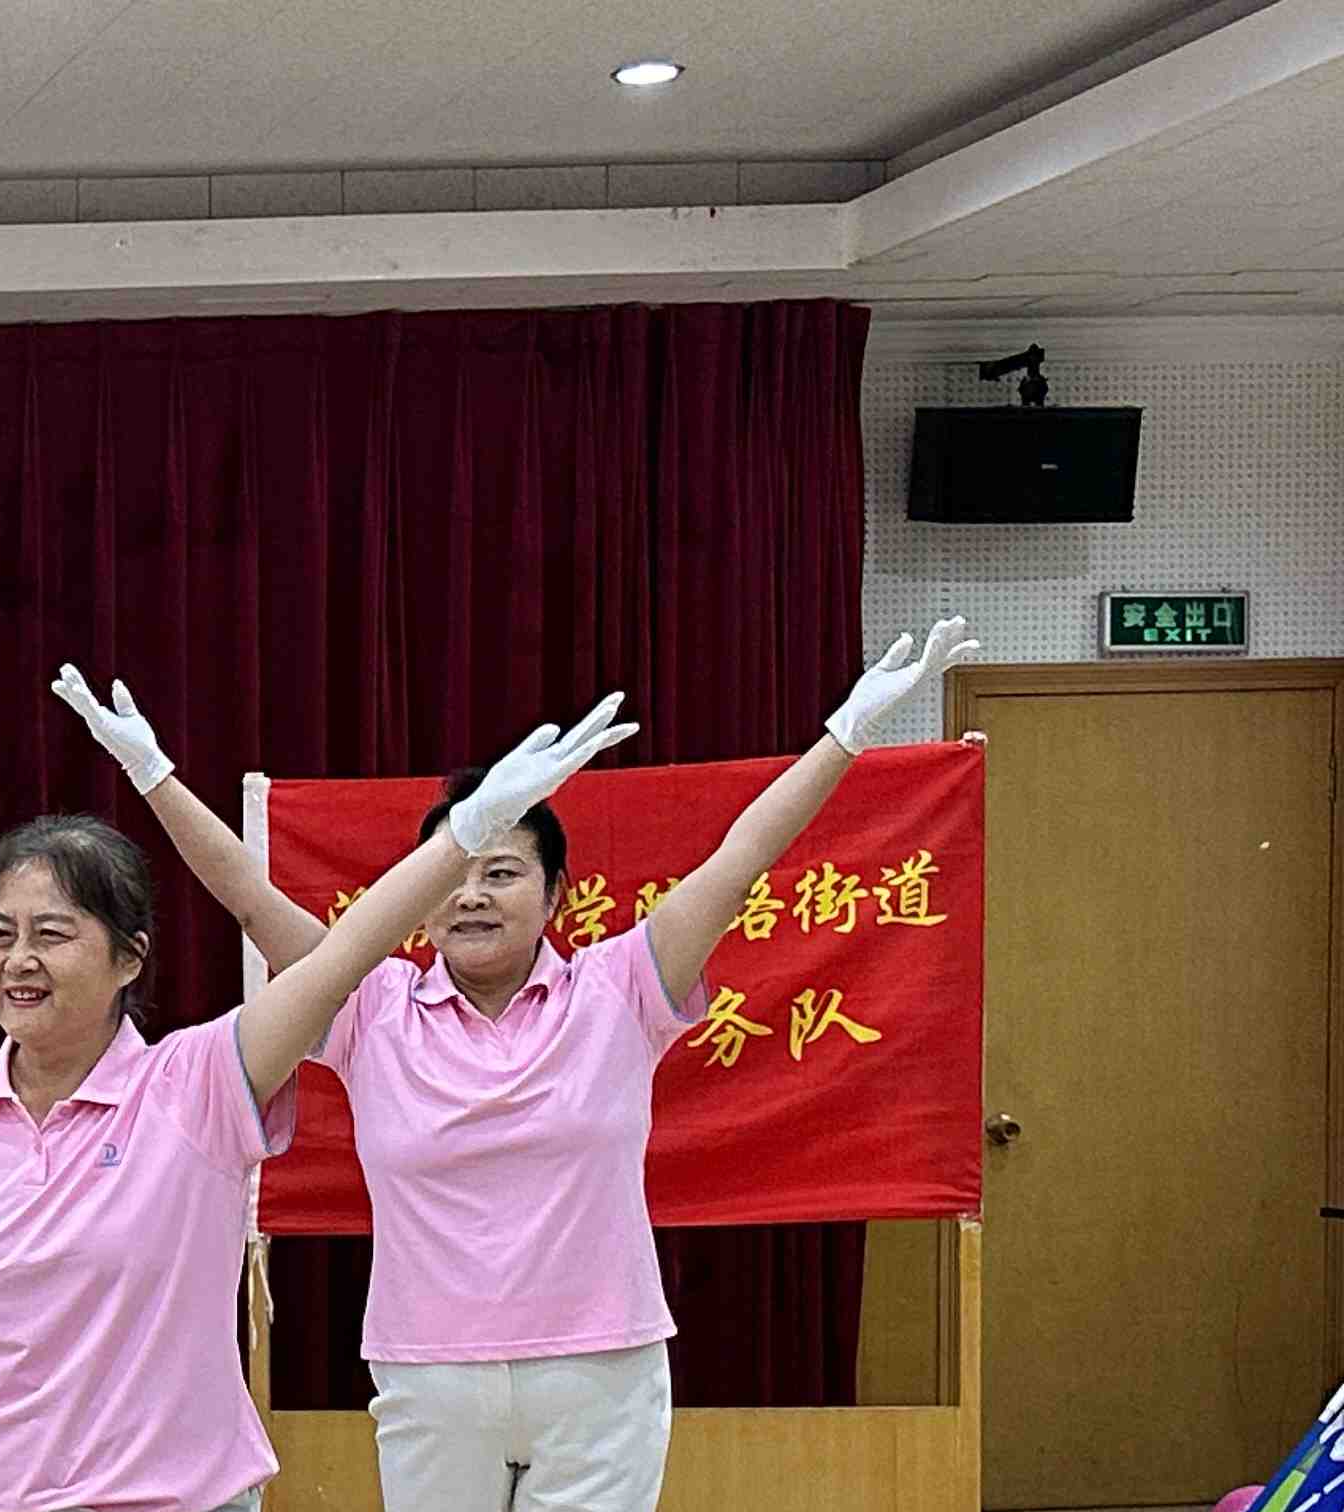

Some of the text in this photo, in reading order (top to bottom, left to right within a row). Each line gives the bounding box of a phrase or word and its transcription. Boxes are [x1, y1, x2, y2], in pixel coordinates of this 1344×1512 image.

[1122, 601, 1232, 628] 安全出口
[1144, 628, 1212, 642] EXIT
